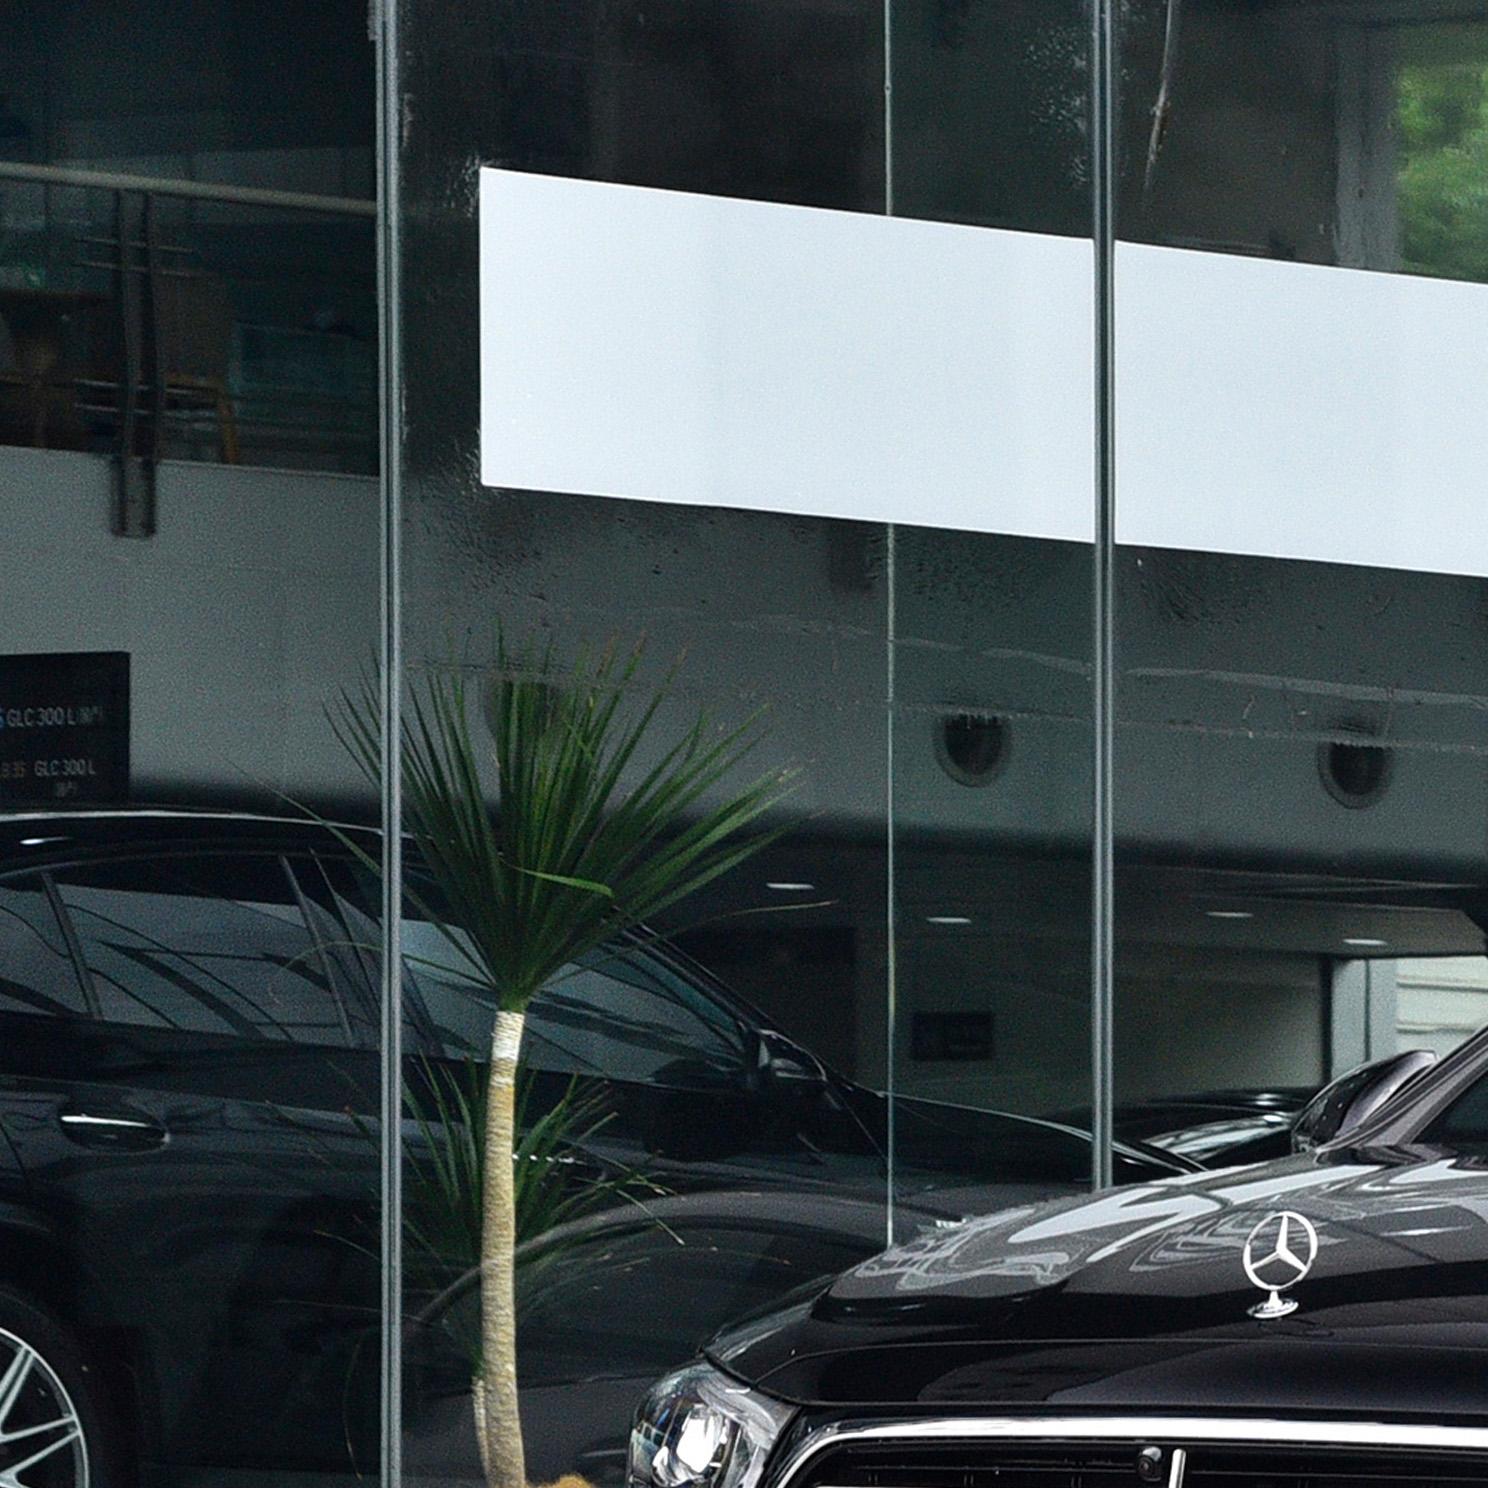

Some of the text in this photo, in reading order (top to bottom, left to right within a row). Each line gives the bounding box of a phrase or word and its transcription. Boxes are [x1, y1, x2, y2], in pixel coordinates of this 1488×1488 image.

[6, 707, 34, 728] GLC
[36, 706, 65, 727] 300
[34, 759, 59, 777] GLC
[61, 758, 86, 777] 300
